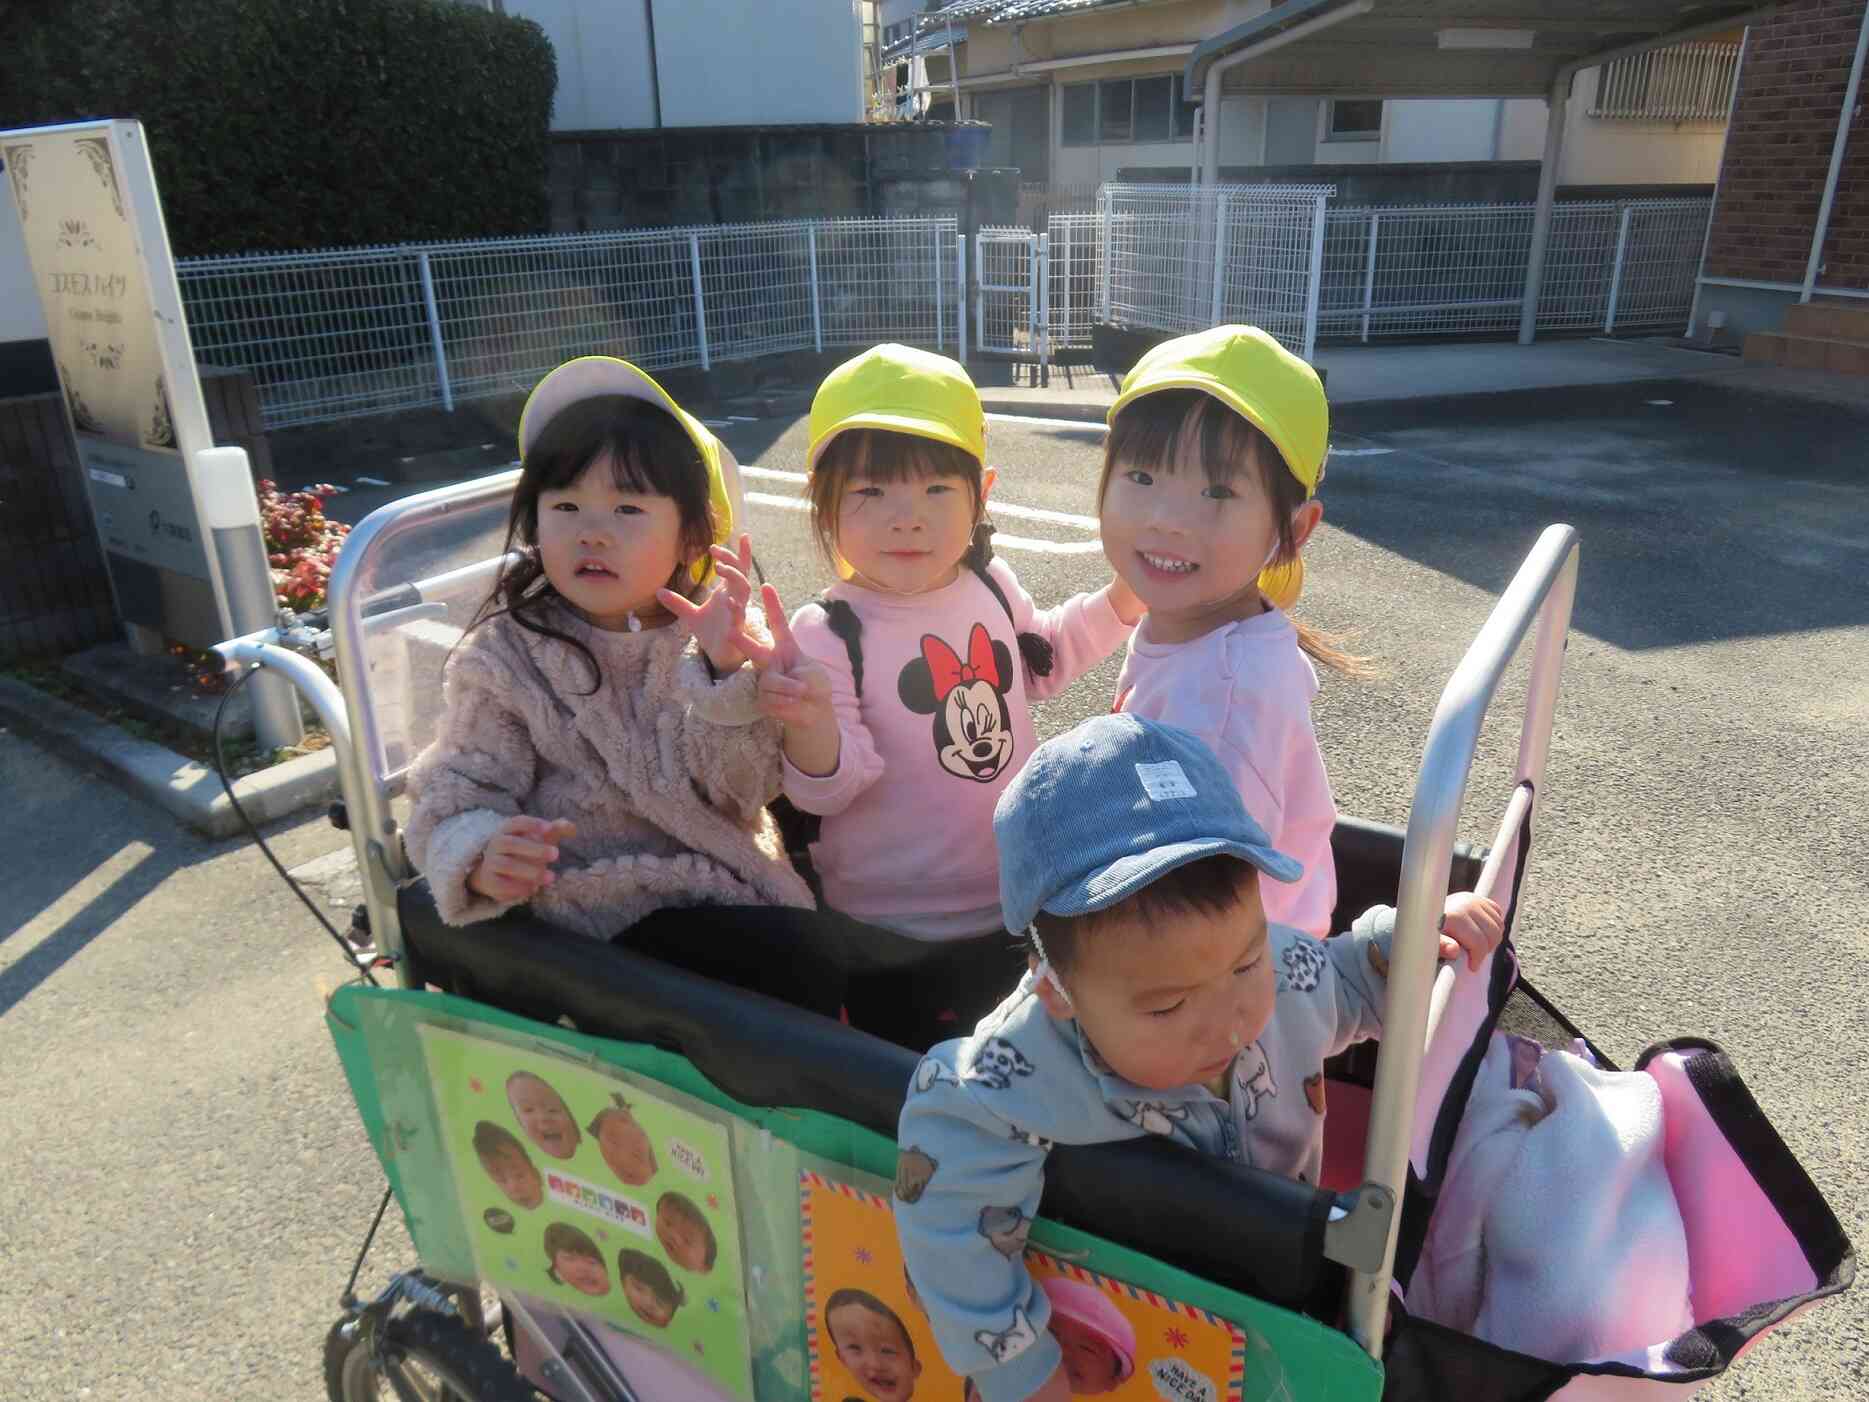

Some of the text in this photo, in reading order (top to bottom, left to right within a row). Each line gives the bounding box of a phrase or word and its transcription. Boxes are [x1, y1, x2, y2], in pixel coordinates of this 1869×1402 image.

[50, 271, 127, 297] コスモスハイツ
[1156, 1367, 1185, 1393] NICE
